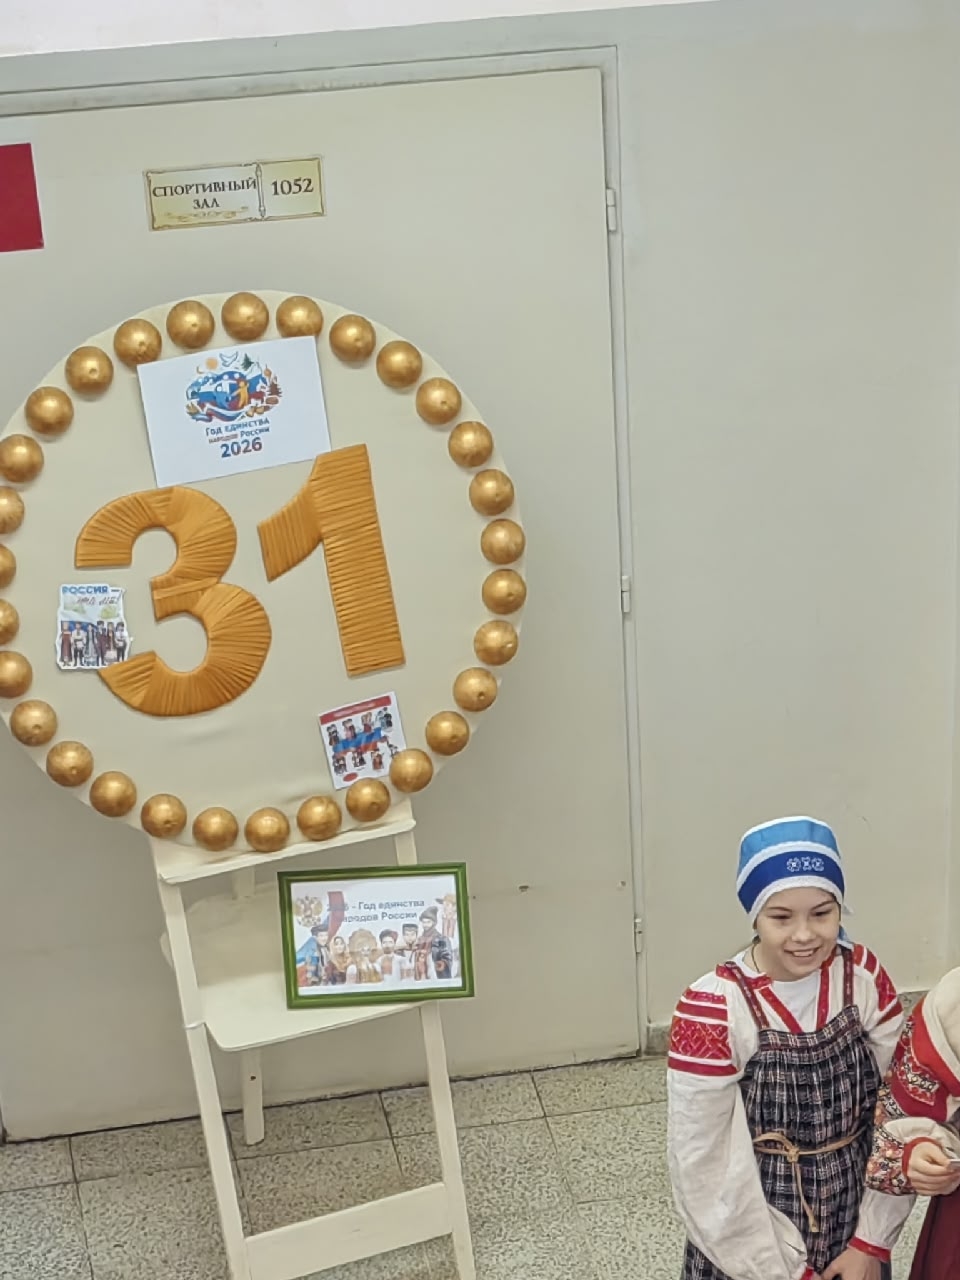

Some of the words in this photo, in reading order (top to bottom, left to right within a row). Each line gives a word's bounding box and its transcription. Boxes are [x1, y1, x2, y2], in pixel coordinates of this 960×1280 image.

[152, 177, 257, 197] СПОРТИВНЫЙ
[271, 178, 314, 196] 1052
[193, 198, 220, 209] ЗАЛ
[220, 437, 262, 458] 2026
[75, 444, 405, 717] 31
[381, 912, 417, 921] России
